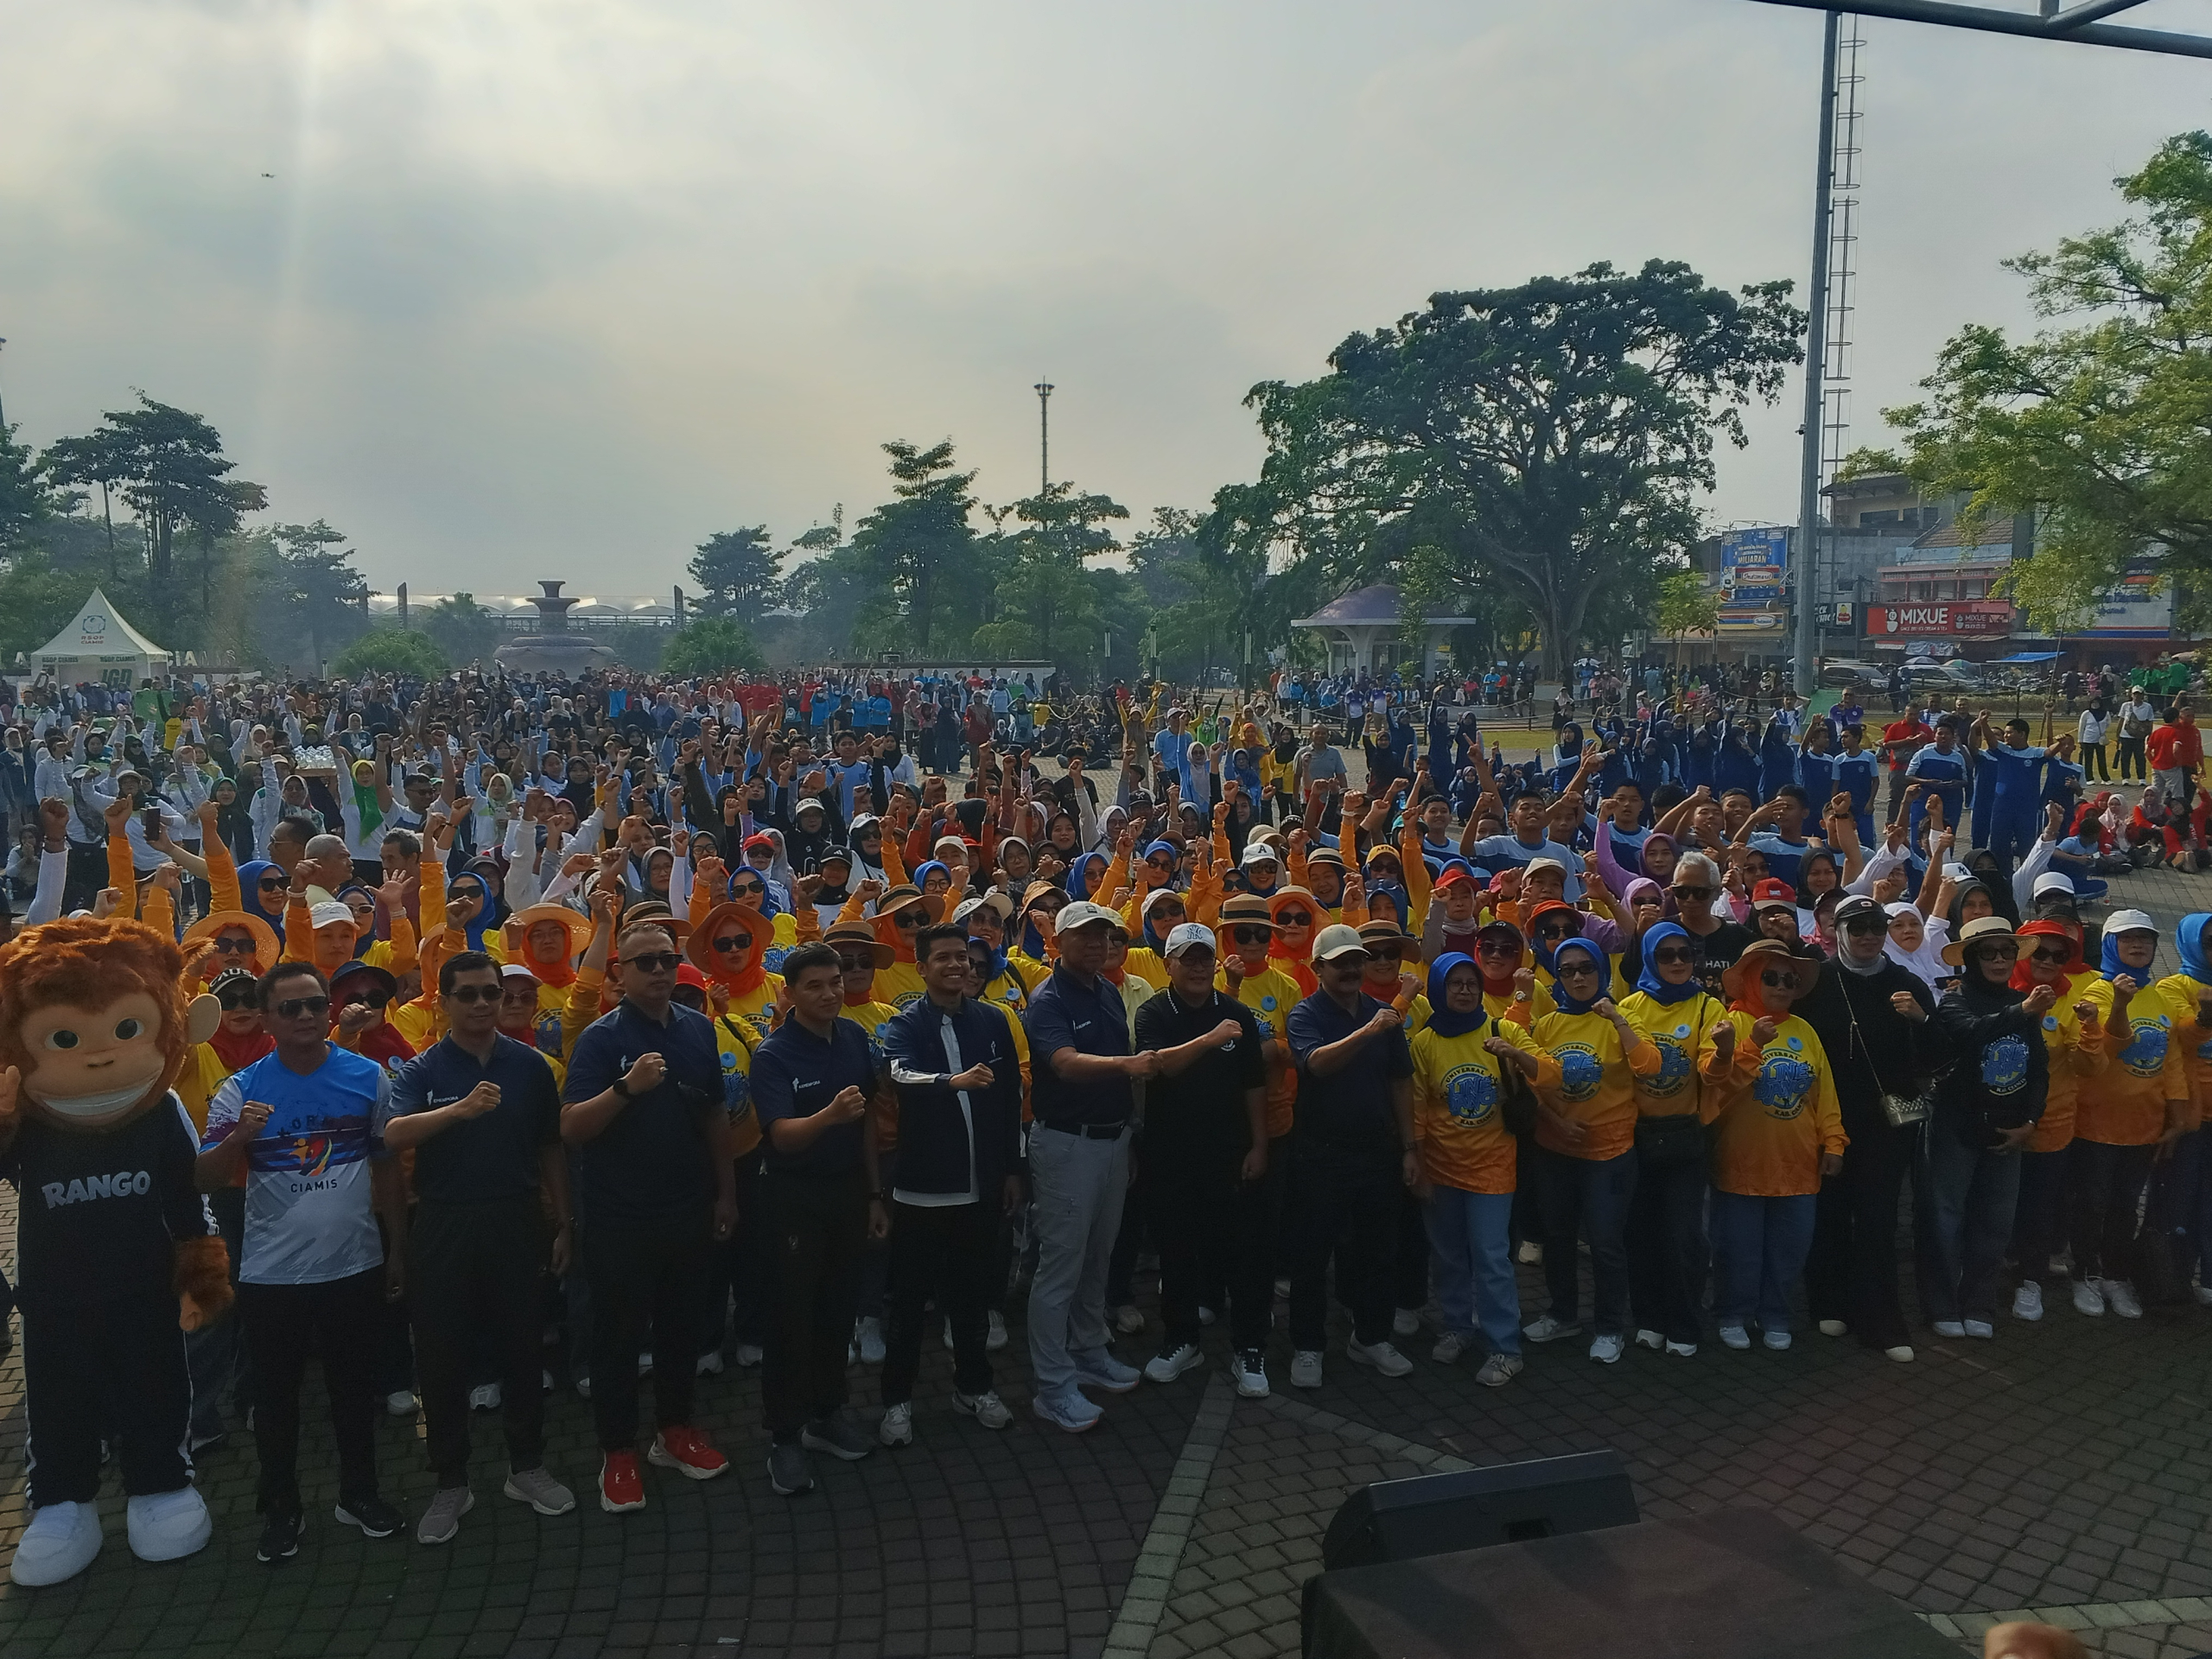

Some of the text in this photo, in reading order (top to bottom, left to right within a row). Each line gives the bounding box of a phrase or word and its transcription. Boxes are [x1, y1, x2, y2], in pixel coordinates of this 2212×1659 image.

[1900, 607, 1948, 625] MIXUE
[1257, 844, 1267, 854] A
[1553, 1045, 1592, 1056] UNIVERSAL
[1759, 1052, 1799, 1065] UNIVERSAL
[1446, 1067, 1484, 1083] UNIVERSAL
[41, 1170, 151, 1210] RANGO
[290, 1179, 338, 1193] CIAMIS
